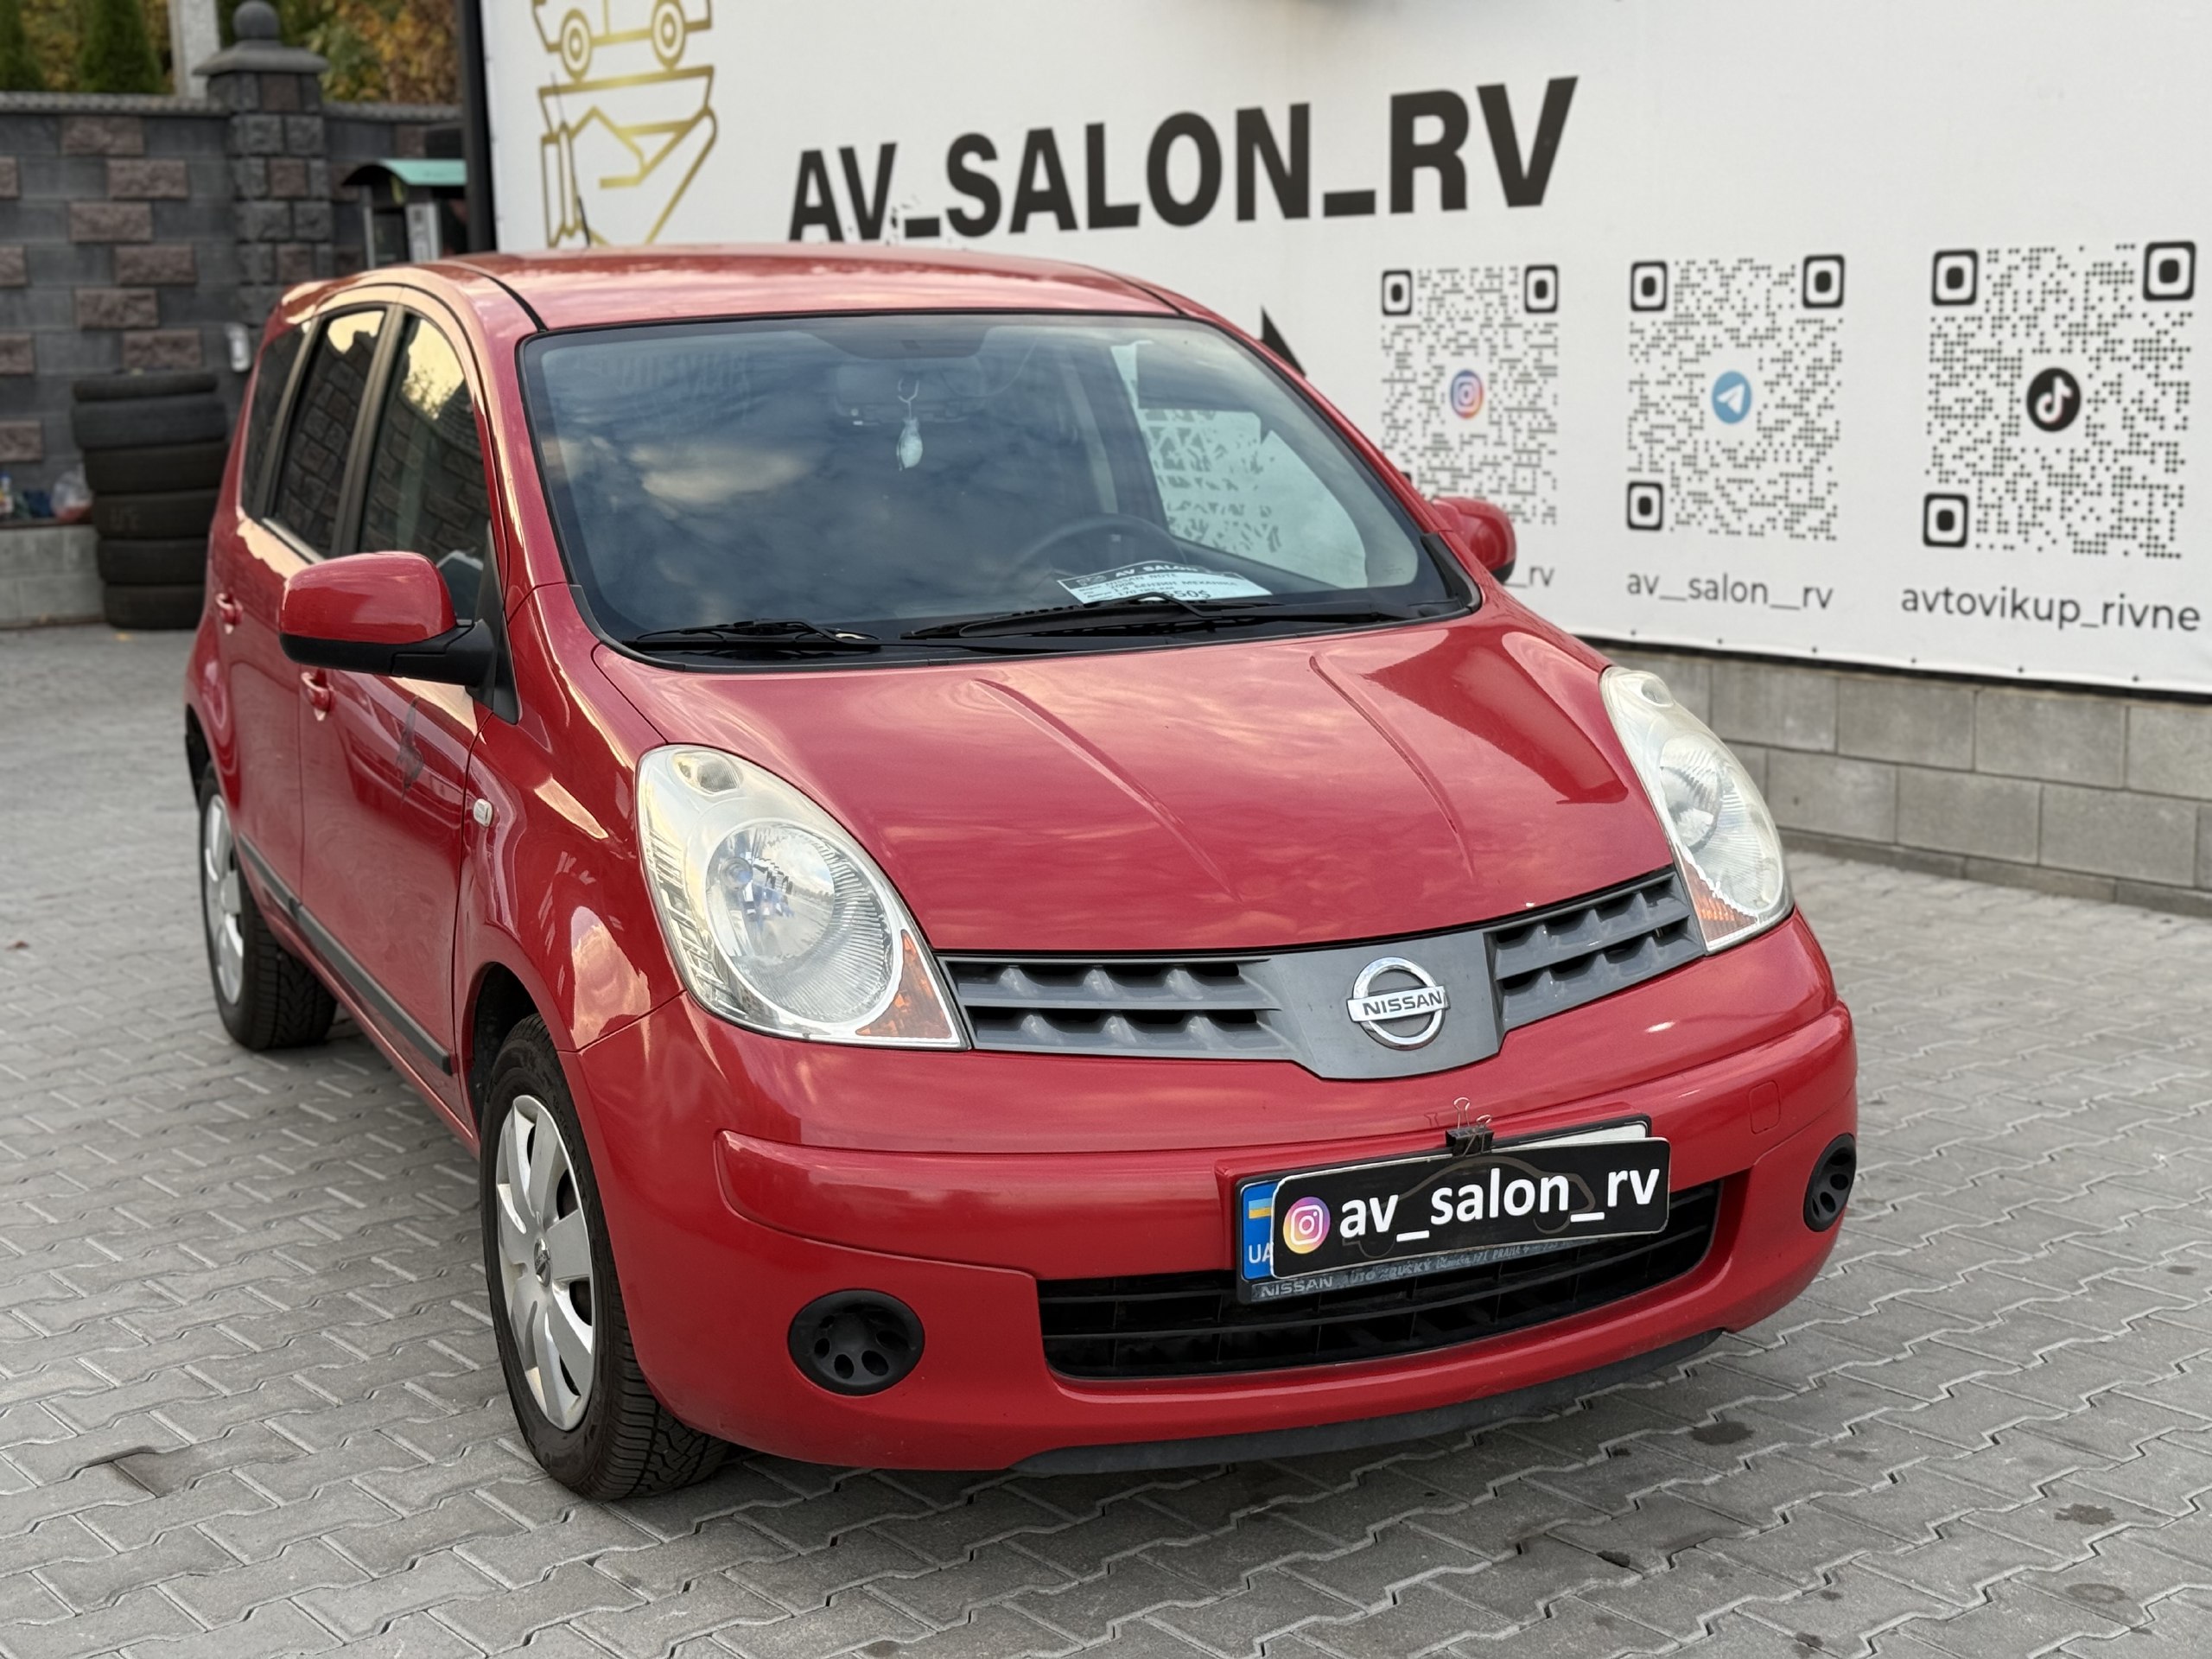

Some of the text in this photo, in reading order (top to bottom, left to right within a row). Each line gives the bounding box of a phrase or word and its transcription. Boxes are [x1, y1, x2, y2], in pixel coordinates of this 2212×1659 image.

[788, 75, 1580, 242] AV_SALON_RV
[1901, 586, 2201, 632] avtovikup_rivne
[1363, 990, 1442, 1016] NISSAN
[1339, 1167, 1660, 1242] av_salon_rv
[1249, 1242, 1273, 1264] UA
[1261, 1275, 1333, 1298] NISSAN
